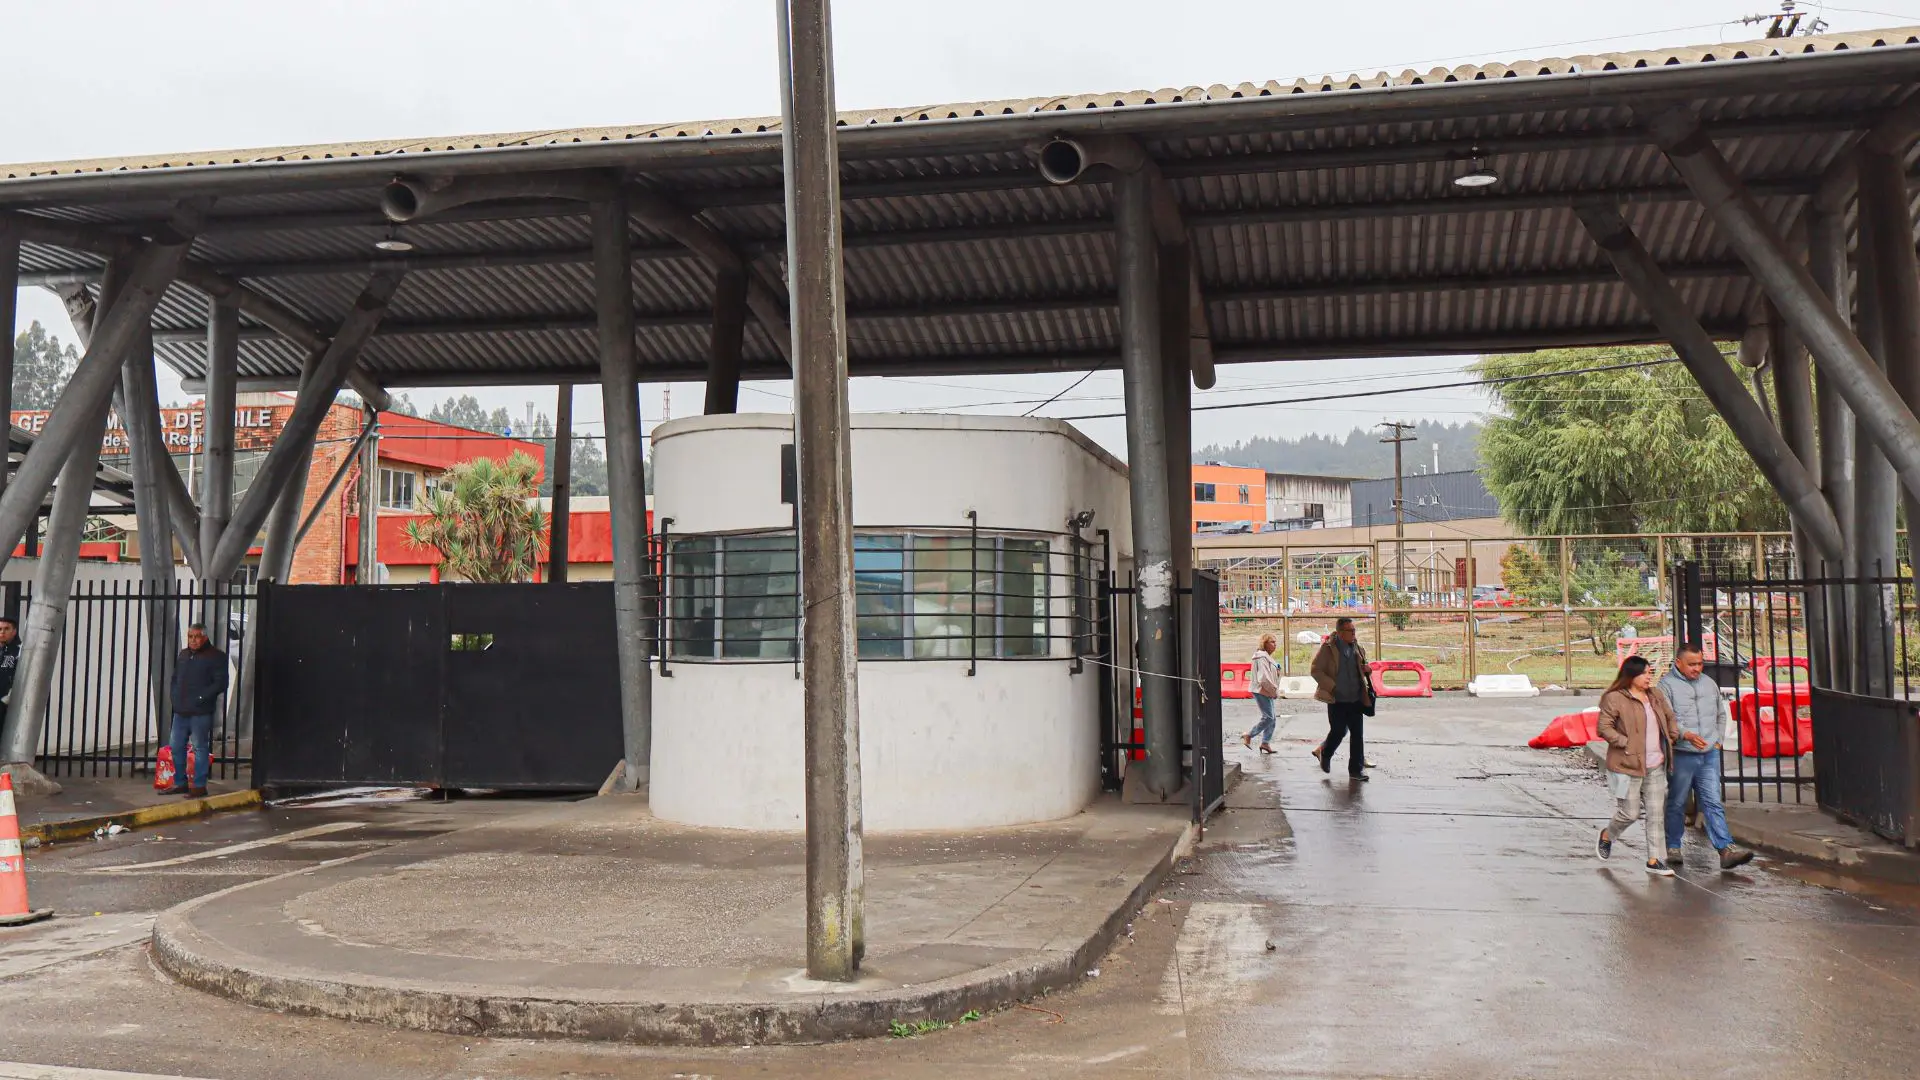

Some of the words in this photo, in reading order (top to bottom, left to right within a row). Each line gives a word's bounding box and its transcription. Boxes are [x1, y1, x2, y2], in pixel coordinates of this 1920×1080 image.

[175, 411, 203, 429] DE
[234, 409, 272, 428] ILE
[103, 433, 121, 447] de
